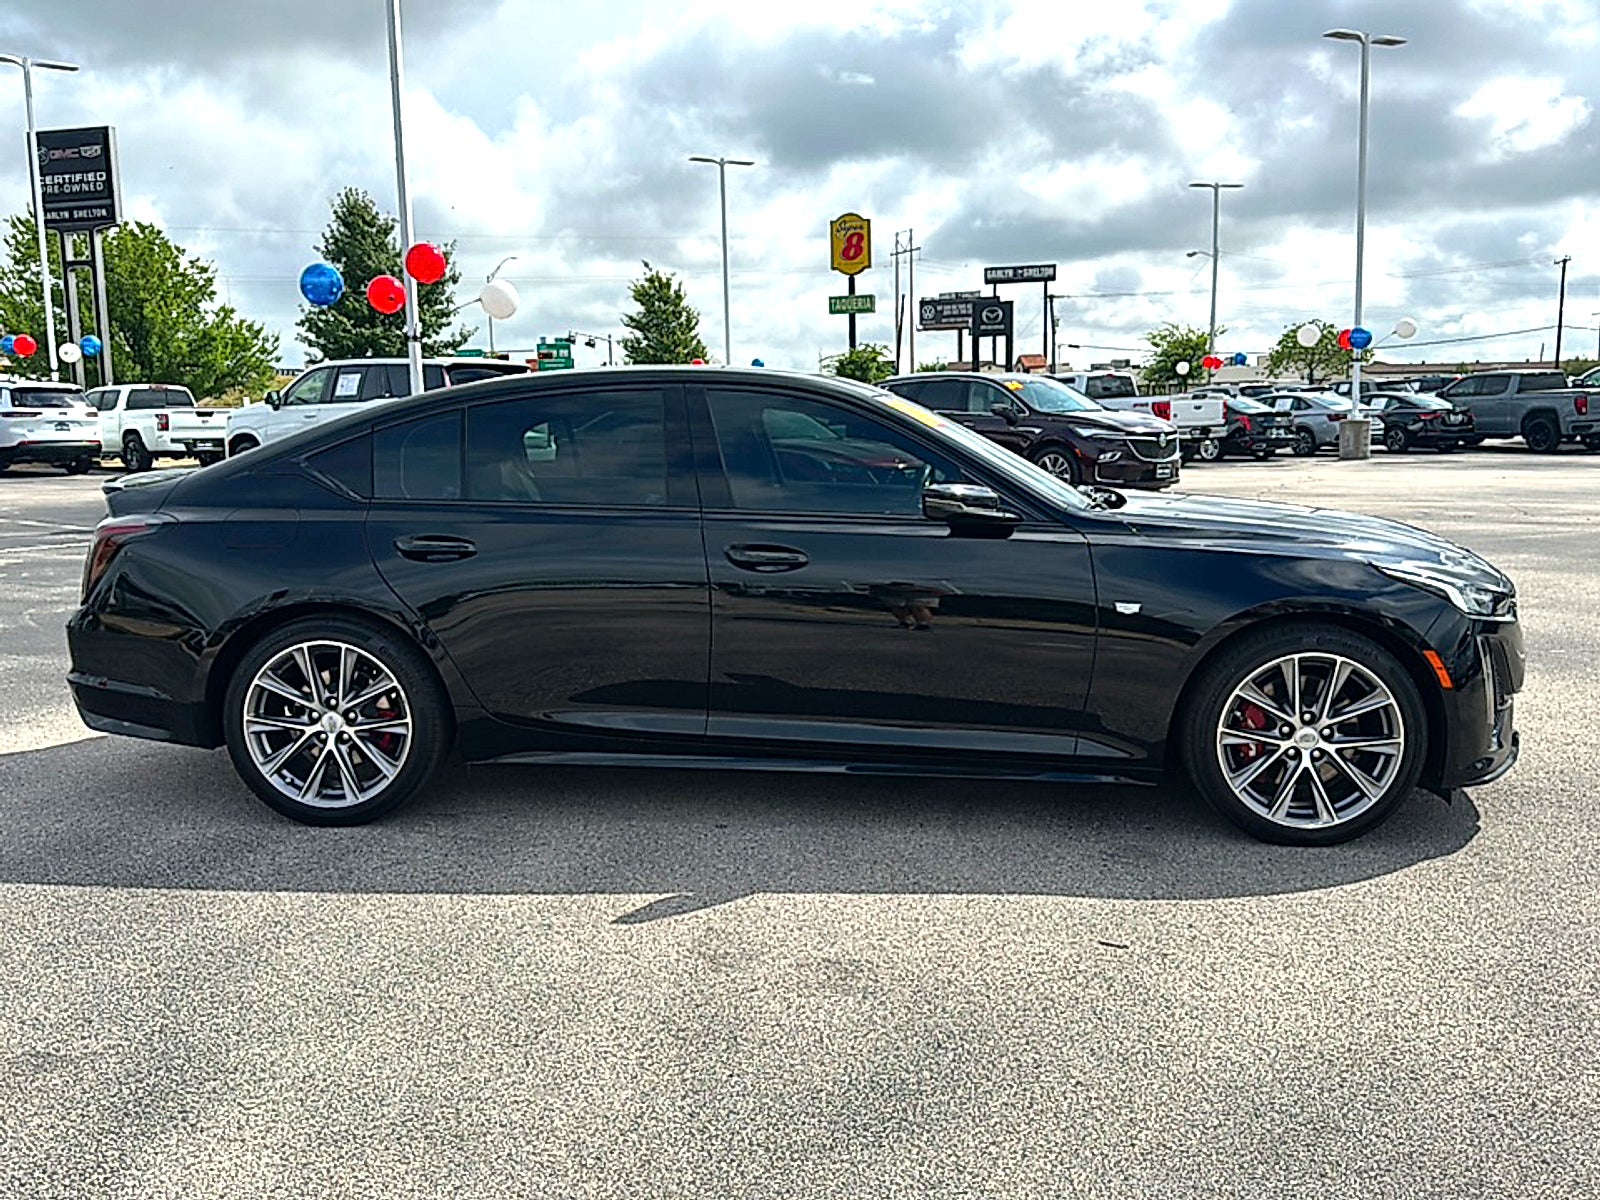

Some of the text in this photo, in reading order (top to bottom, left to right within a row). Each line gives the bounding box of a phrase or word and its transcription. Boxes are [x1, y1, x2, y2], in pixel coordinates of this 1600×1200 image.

[49, 148, 80, 160] GMC
[40, 171, 106, 184] CERTIFIED
[44, 208, 108, 219] ARLYN SHELTON
[842, 232, 865, 261] 8
[830, 297, 872, 312] TAQUERIA
